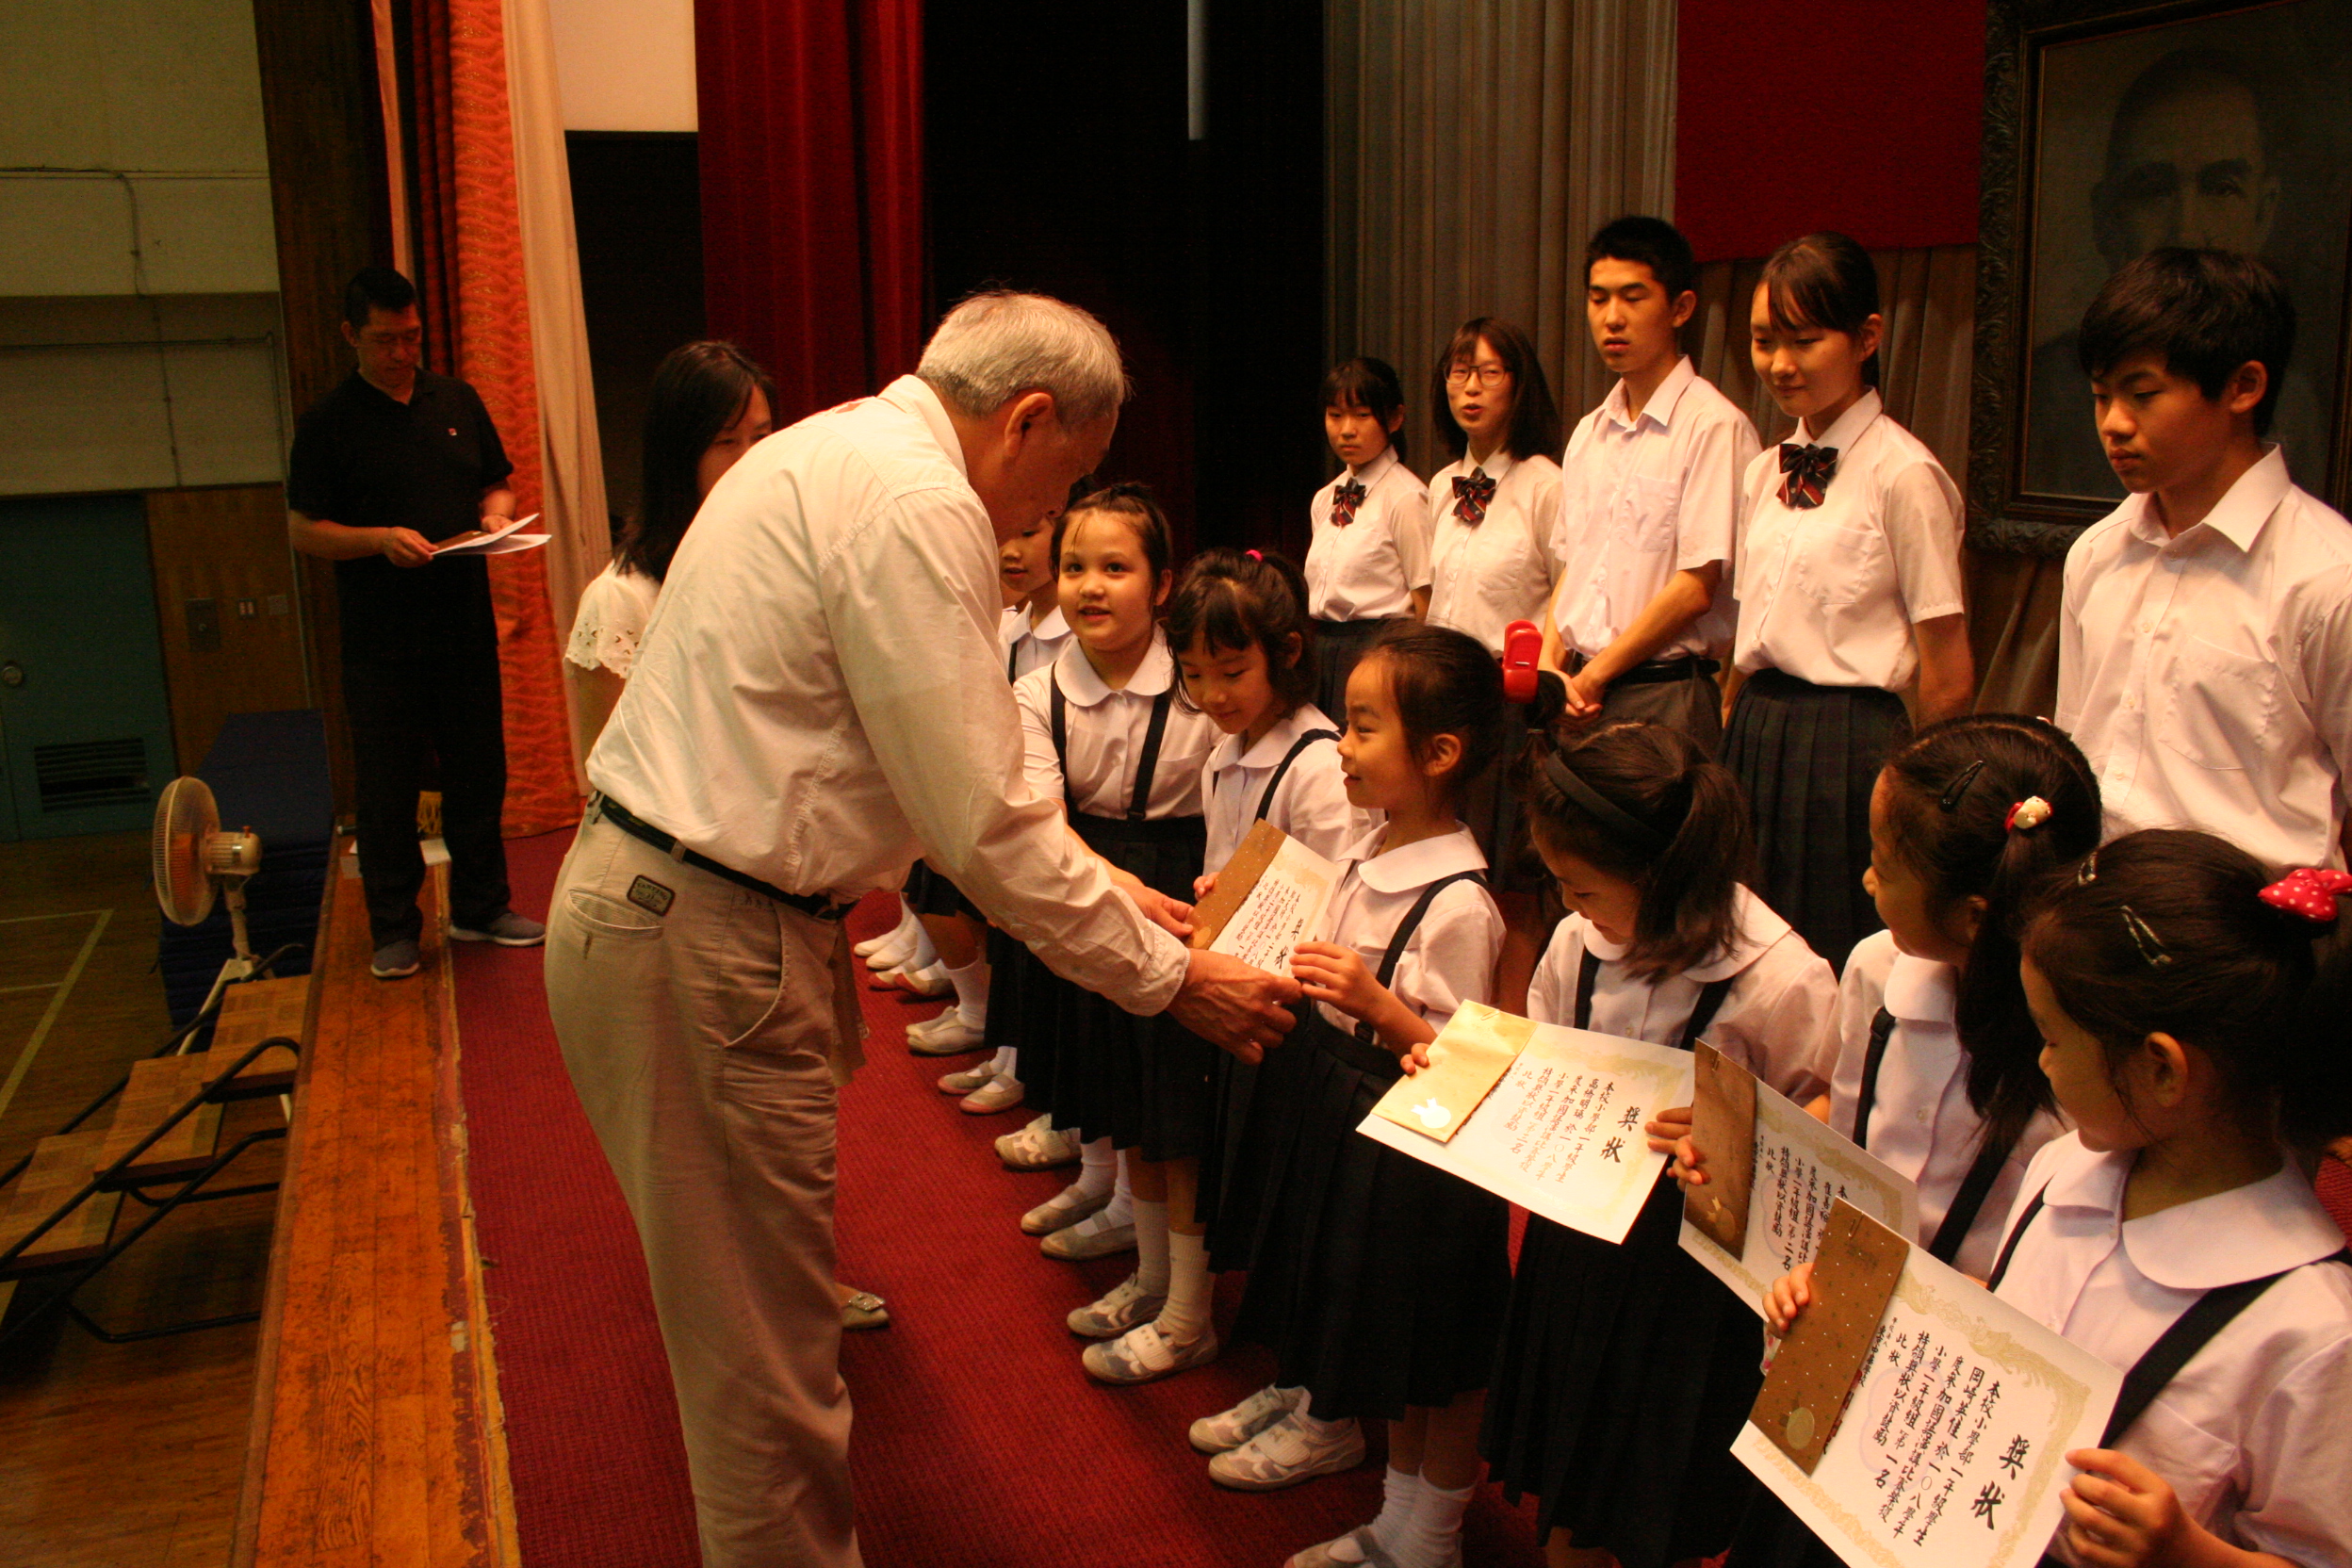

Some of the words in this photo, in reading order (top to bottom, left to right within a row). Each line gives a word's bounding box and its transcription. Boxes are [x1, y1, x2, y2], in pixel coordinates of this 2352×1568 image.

[1515, 1070, 1532, 1089] 此狀
[1599, 1105, 1641, 1163] 獎狀
[1888, 1331, 1907, 1367] 此狀
[1874, 1346, 1947, 1489] 小學一年級組第一名
[1913, 1380, 2001, 1546] 本校小學部一年級學生
[1971, 1434, 2030, 1530] 獎狀
